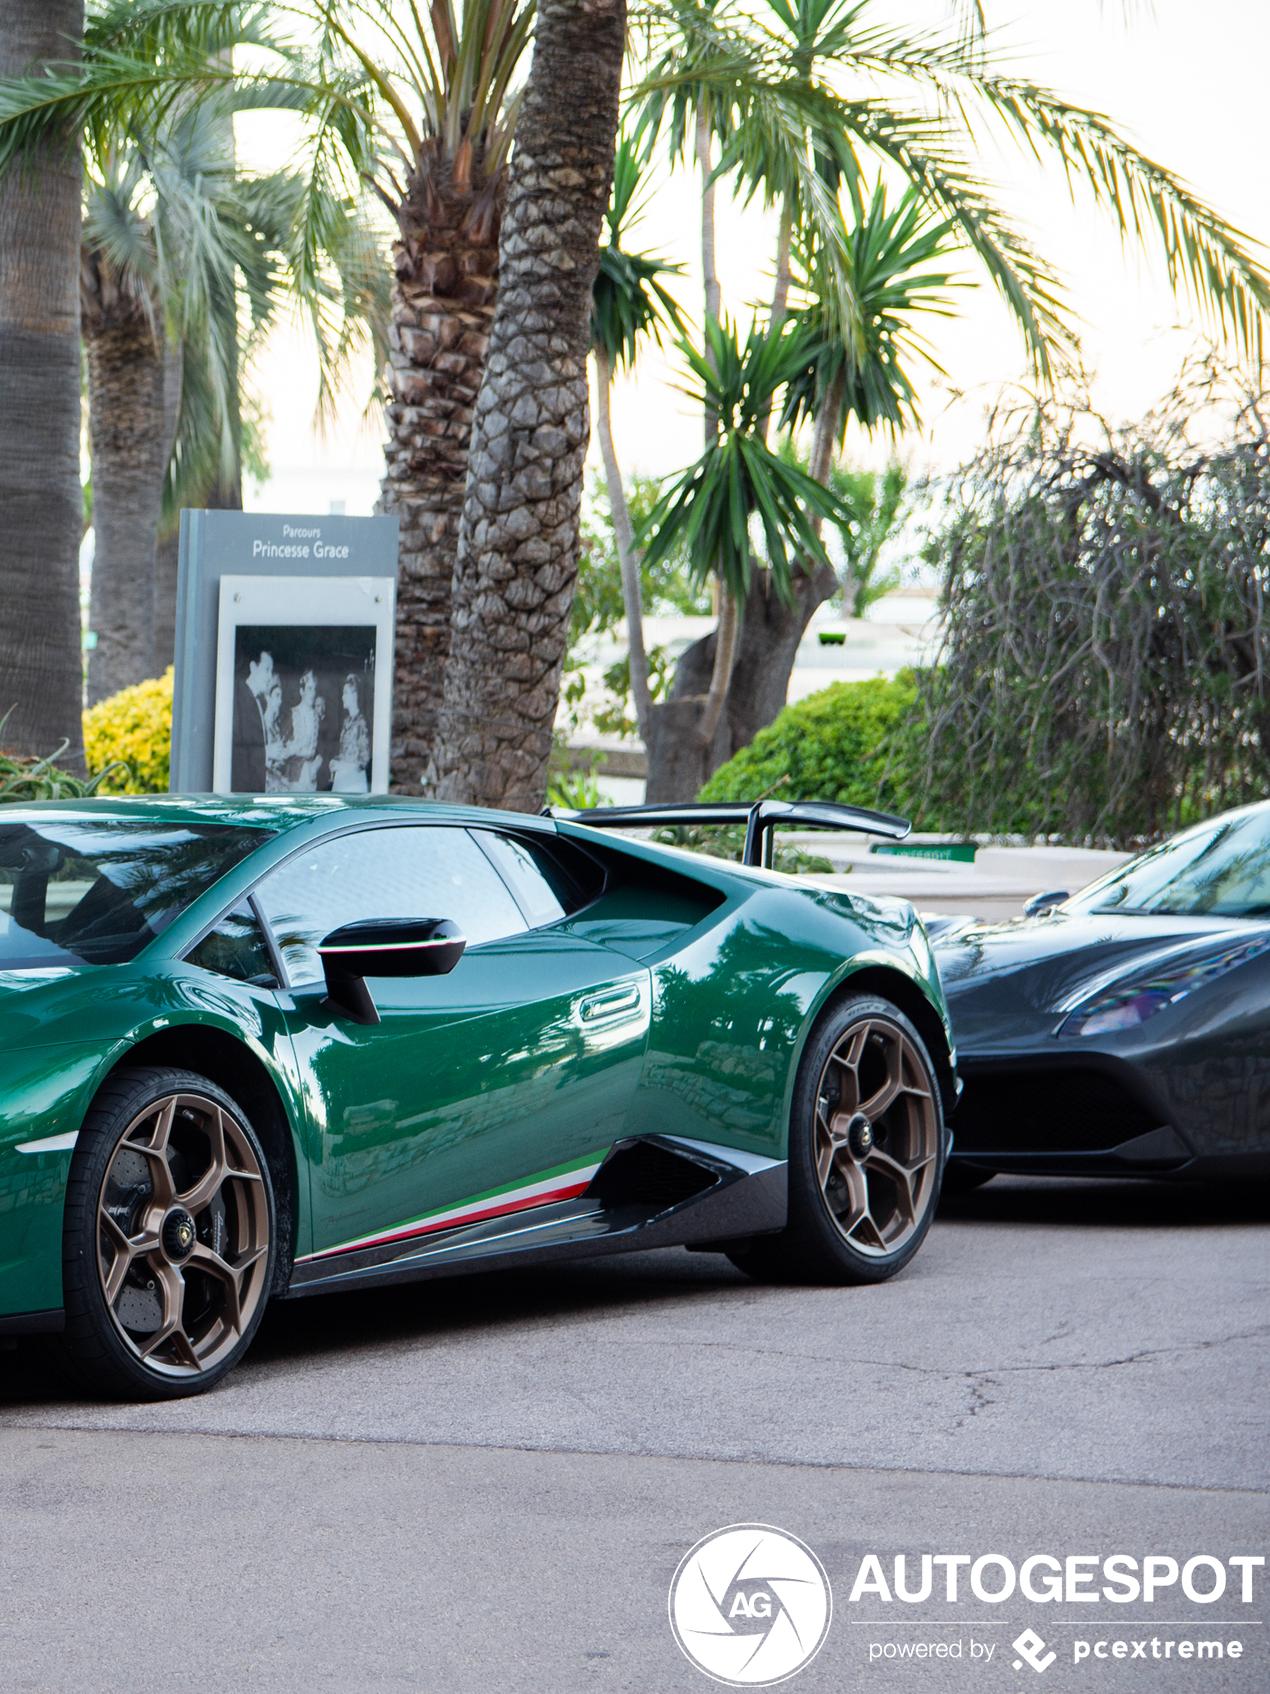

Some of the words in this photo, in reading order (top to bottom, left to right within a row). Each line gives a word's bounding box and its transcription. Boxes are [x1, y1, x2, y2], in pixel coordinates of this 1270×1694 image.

[283, 524, 321, 538] Parcours
[253, 540, 310, 558] Princesse
[313, 541, 349, 558] Grace
